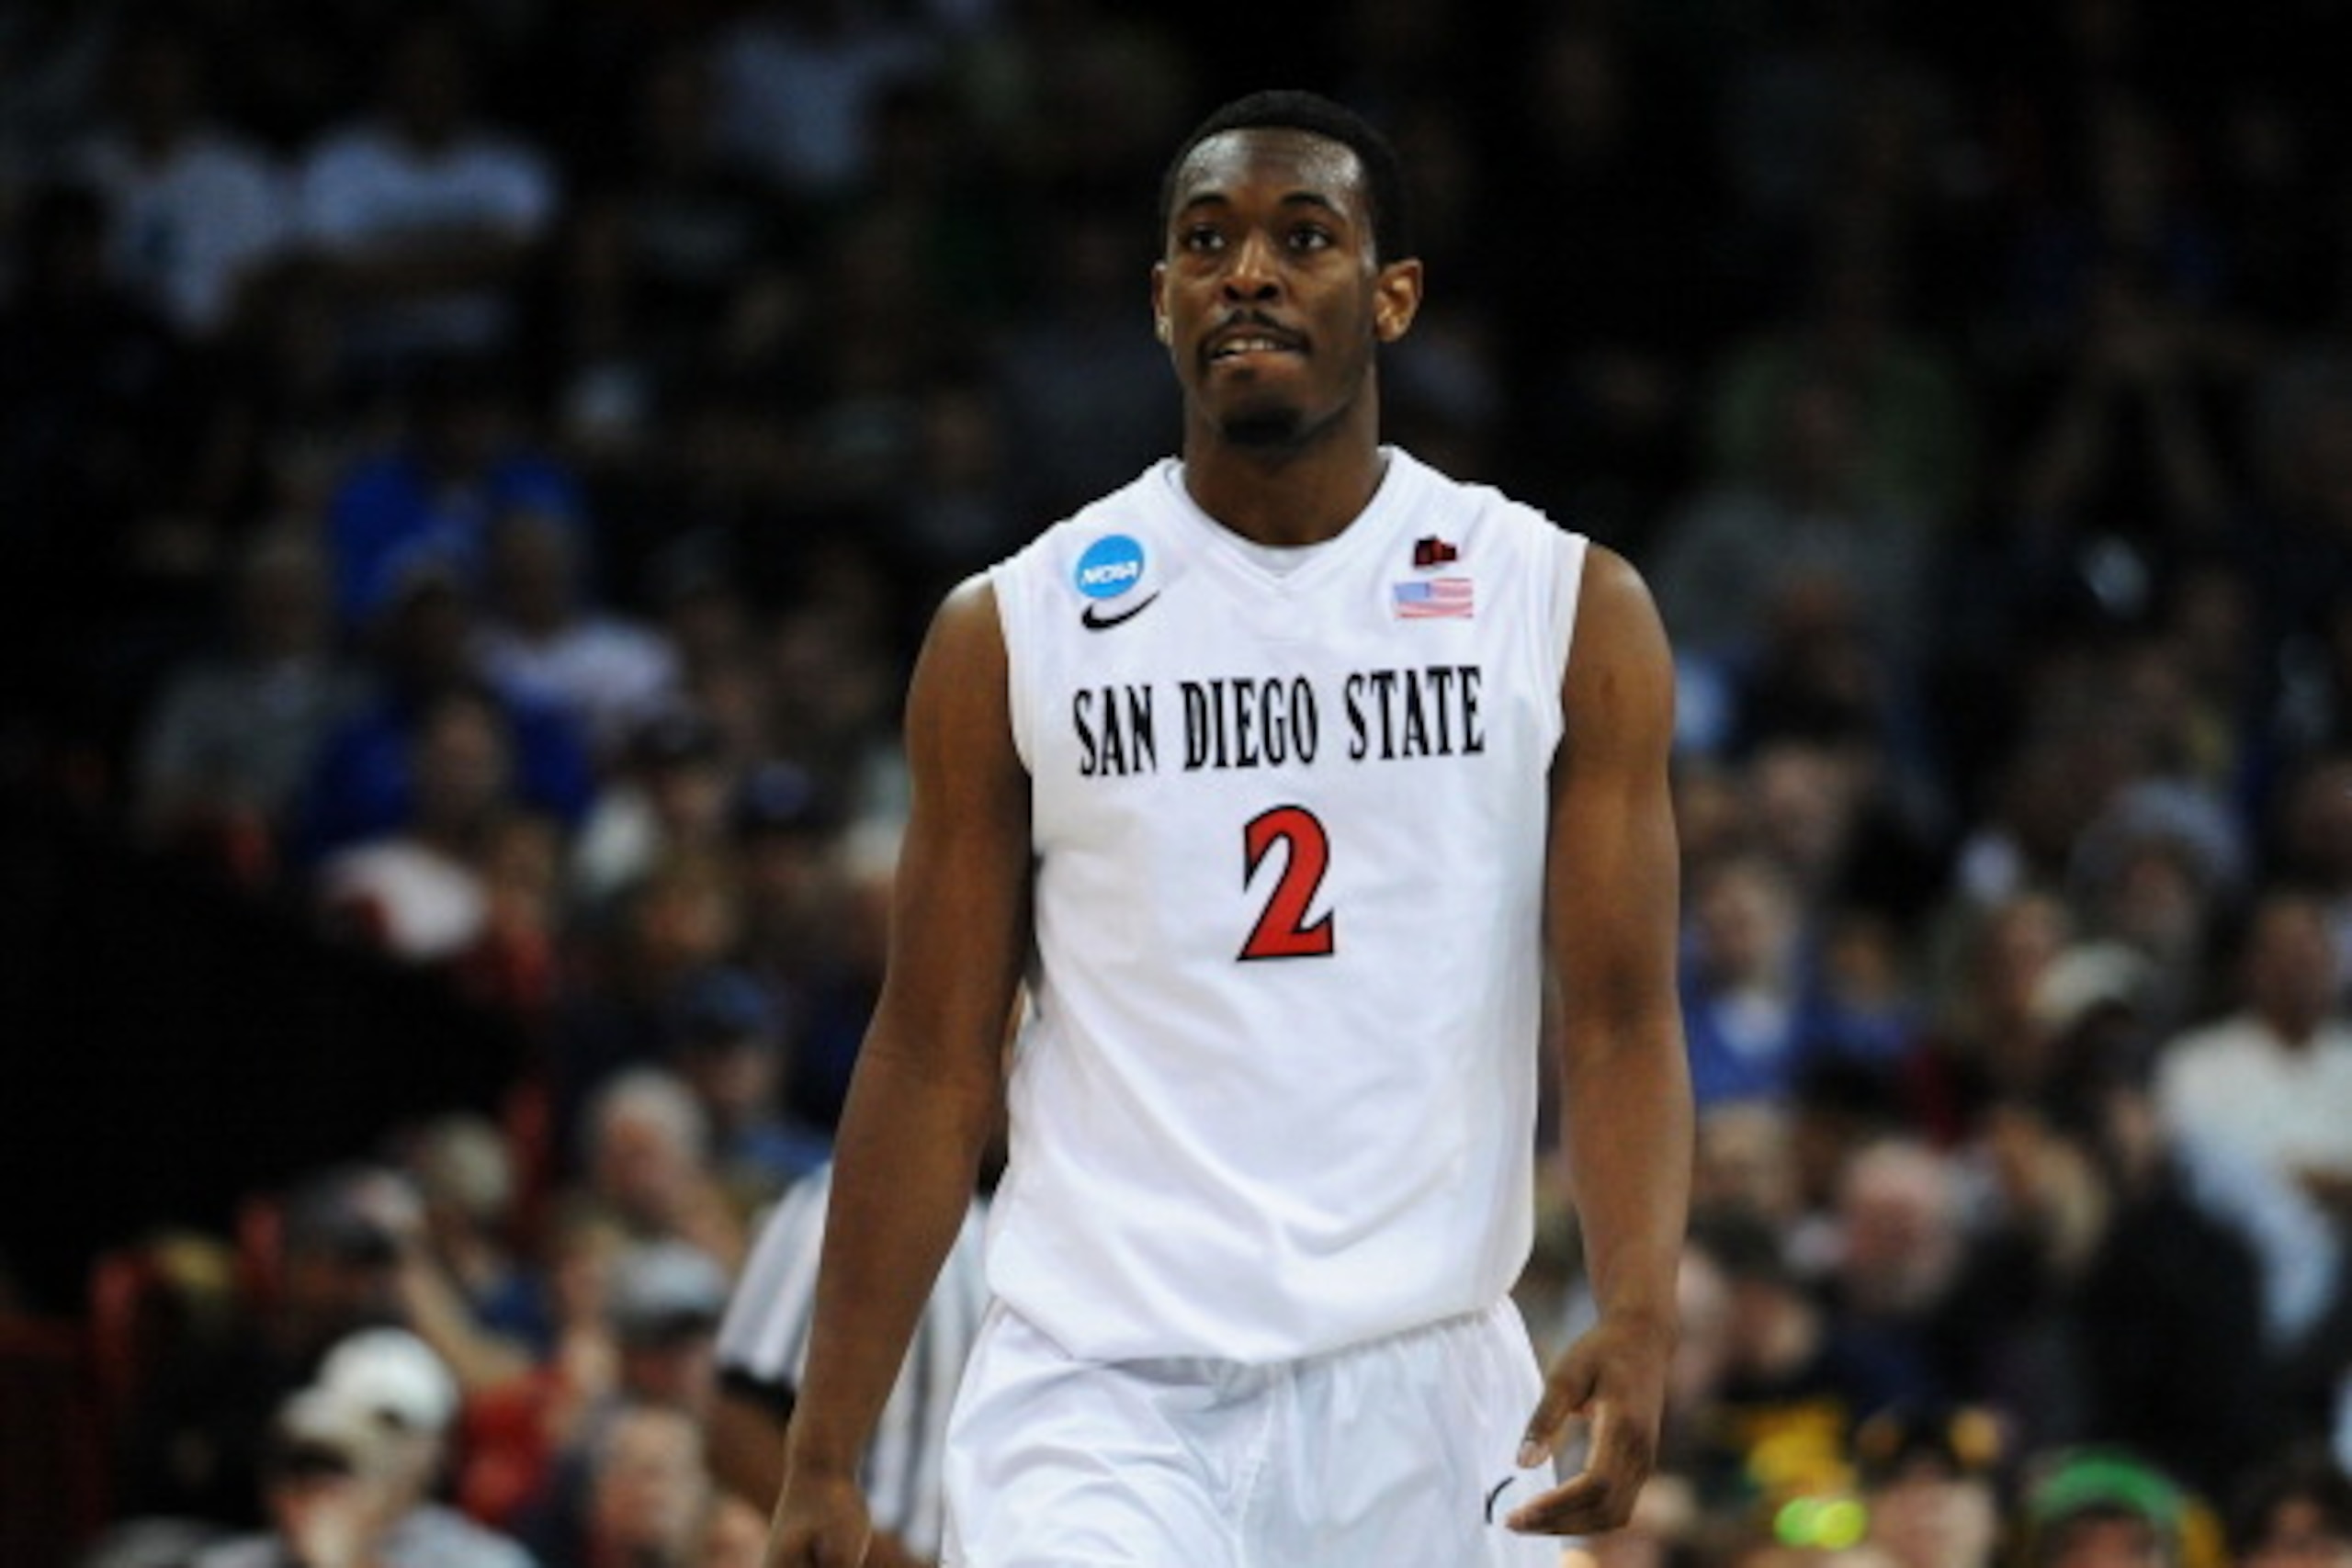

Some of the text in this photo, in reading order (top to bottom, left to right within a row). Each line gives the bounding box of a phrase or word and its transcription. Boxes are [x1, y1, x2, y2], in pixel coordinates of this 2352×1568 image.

[1073, 666, 1484, 777] SAN DIEGO STATE
[1236, 805, 1334, 963] 2
